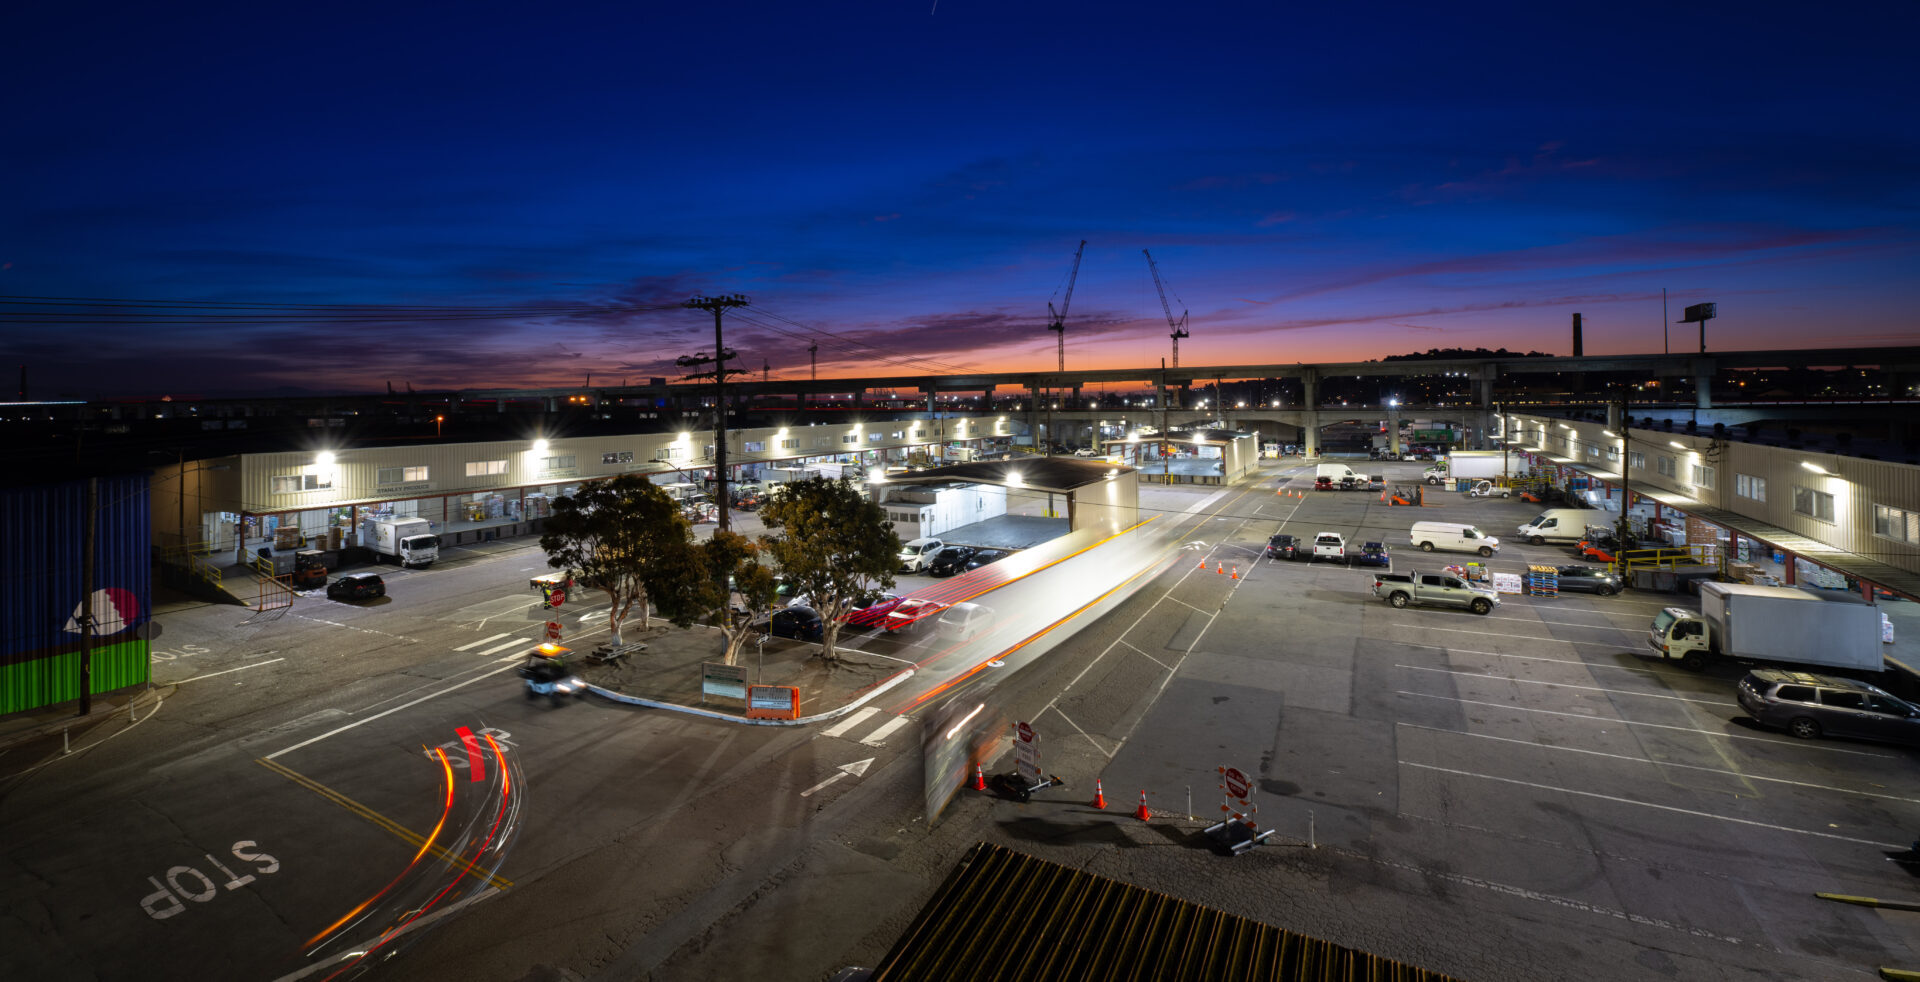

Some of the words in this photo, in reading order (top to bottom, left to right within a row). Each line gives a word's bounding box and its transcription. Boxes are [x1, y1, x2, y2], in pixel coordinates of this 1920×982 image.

[377, 486, 402, 494] STANLEY
[551, 593, 565, 603] STOP
[140, 840, 280, 920] STOP
